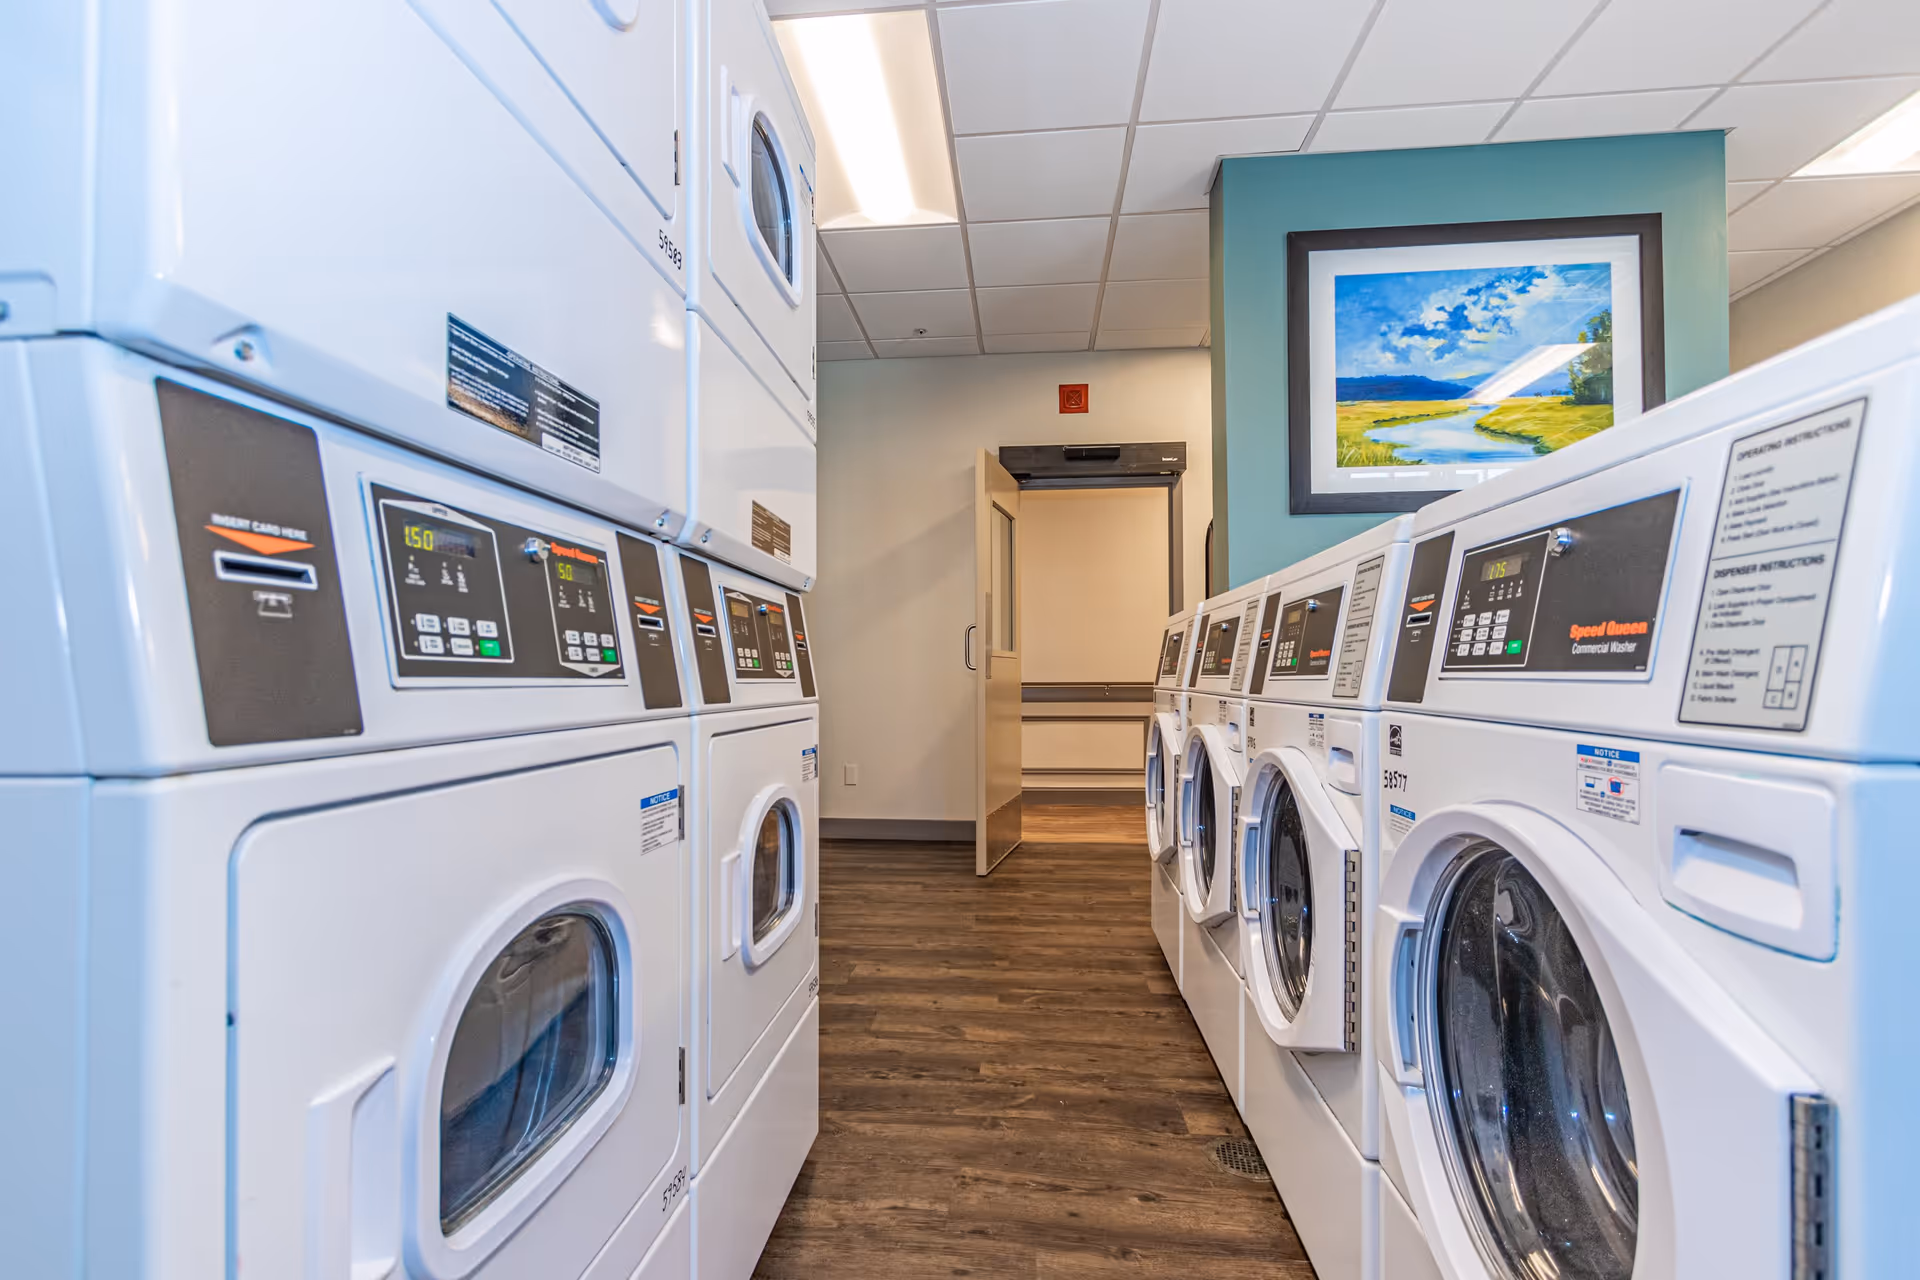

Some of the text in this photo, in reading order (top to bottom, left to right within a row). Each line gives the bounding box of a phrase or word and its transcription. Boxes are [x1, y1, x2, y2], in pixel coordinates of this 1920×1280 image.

[658, 228, 682, 271] 59583
[211, 512, 308, 542] INSERT CARD HERE
[1713, 554, 1825, 579] DISPENSER INSTRUCTIONS
[1569, 620, 1649, 642] Speed Queen
[1571, 641, 1637, 655] Commercial Washer
[1594, 747, 1620, 759] NOTICE
[1383, 769, 1408, 793] 58577
[649, 792, 671, 805] NOTICE
[1393, 806, 1413, 819] NOTICE
